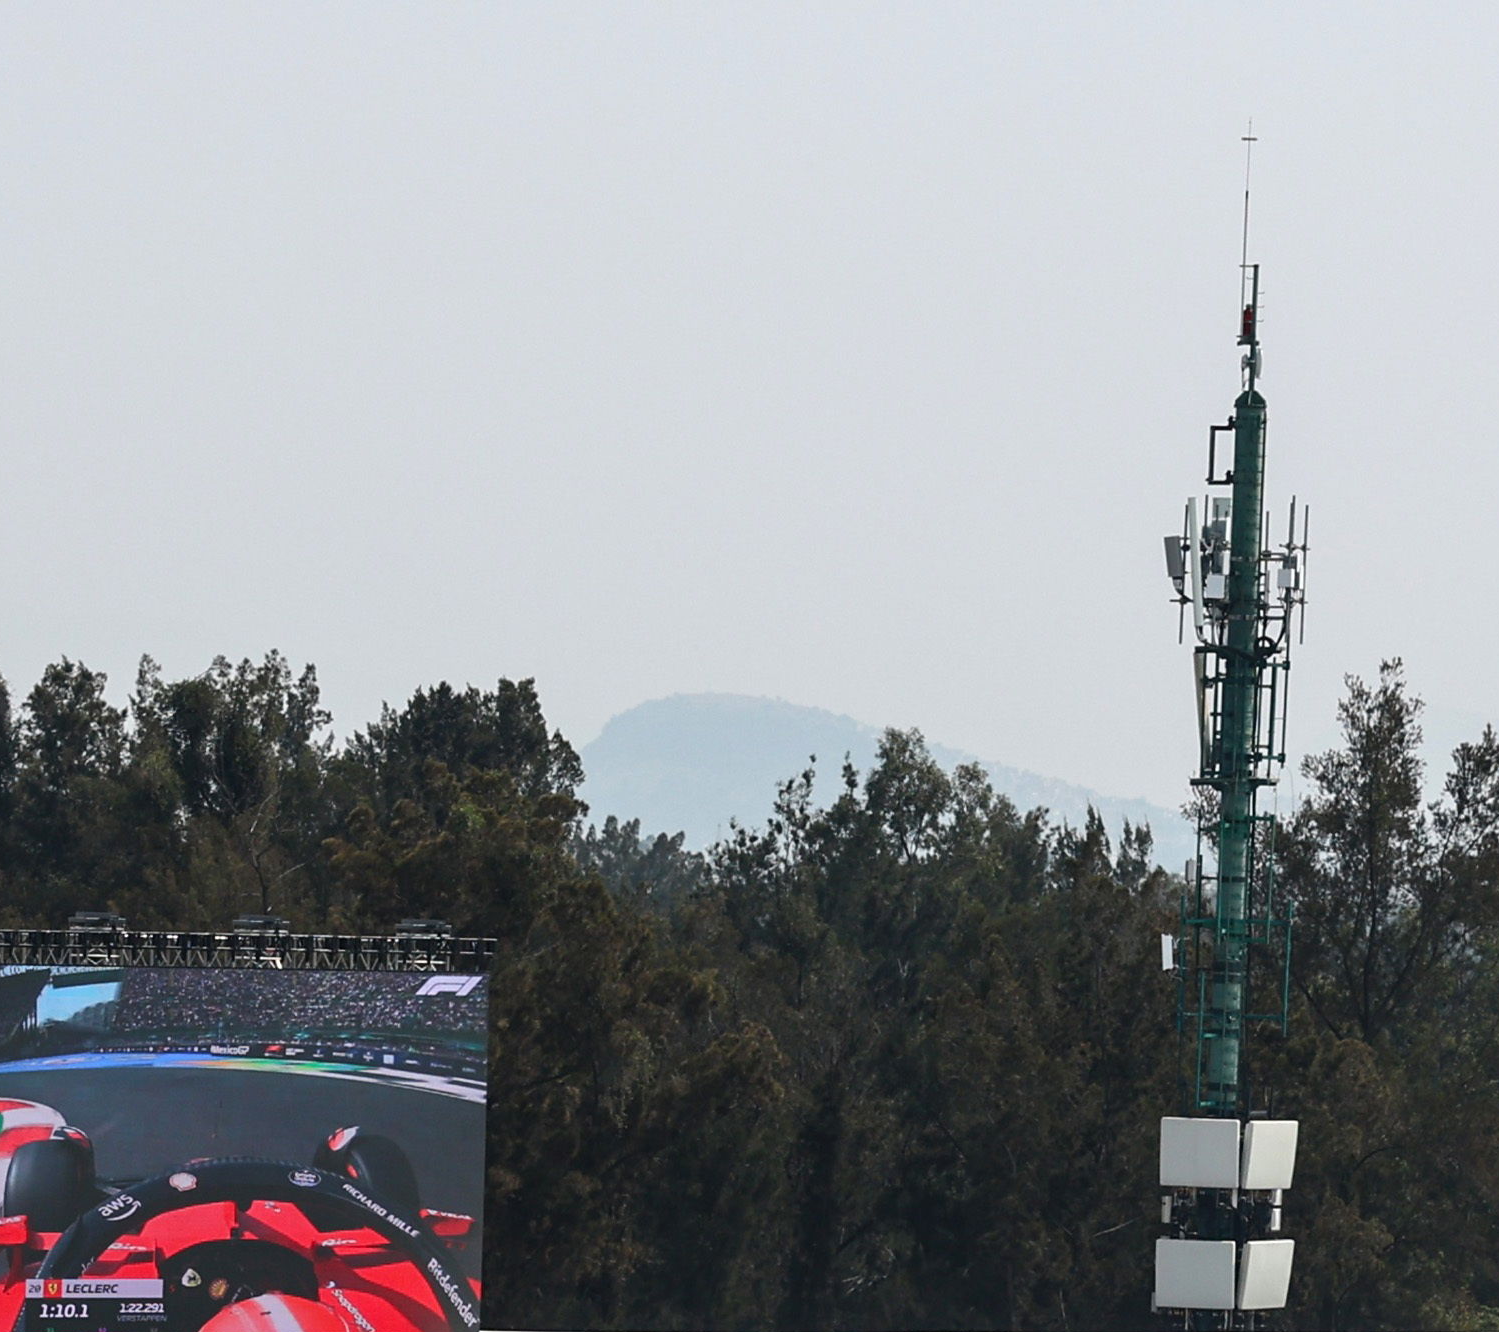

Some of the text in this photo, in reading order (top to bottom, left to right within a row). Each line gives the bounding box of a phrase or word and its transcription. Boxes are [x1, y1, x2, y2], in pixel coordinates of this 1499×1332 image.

[98, 1194, 133, 1217] aws
[343, 1183, 387, 1217] RICHARD
[386, 1214, 421, 1239] MILLE
[28, 1284, 119, 1293] 20 LECLERC
[427, 1257, 479, 1328] Bitdefender
[39, 1304, 89, 1318] 1:10.1
